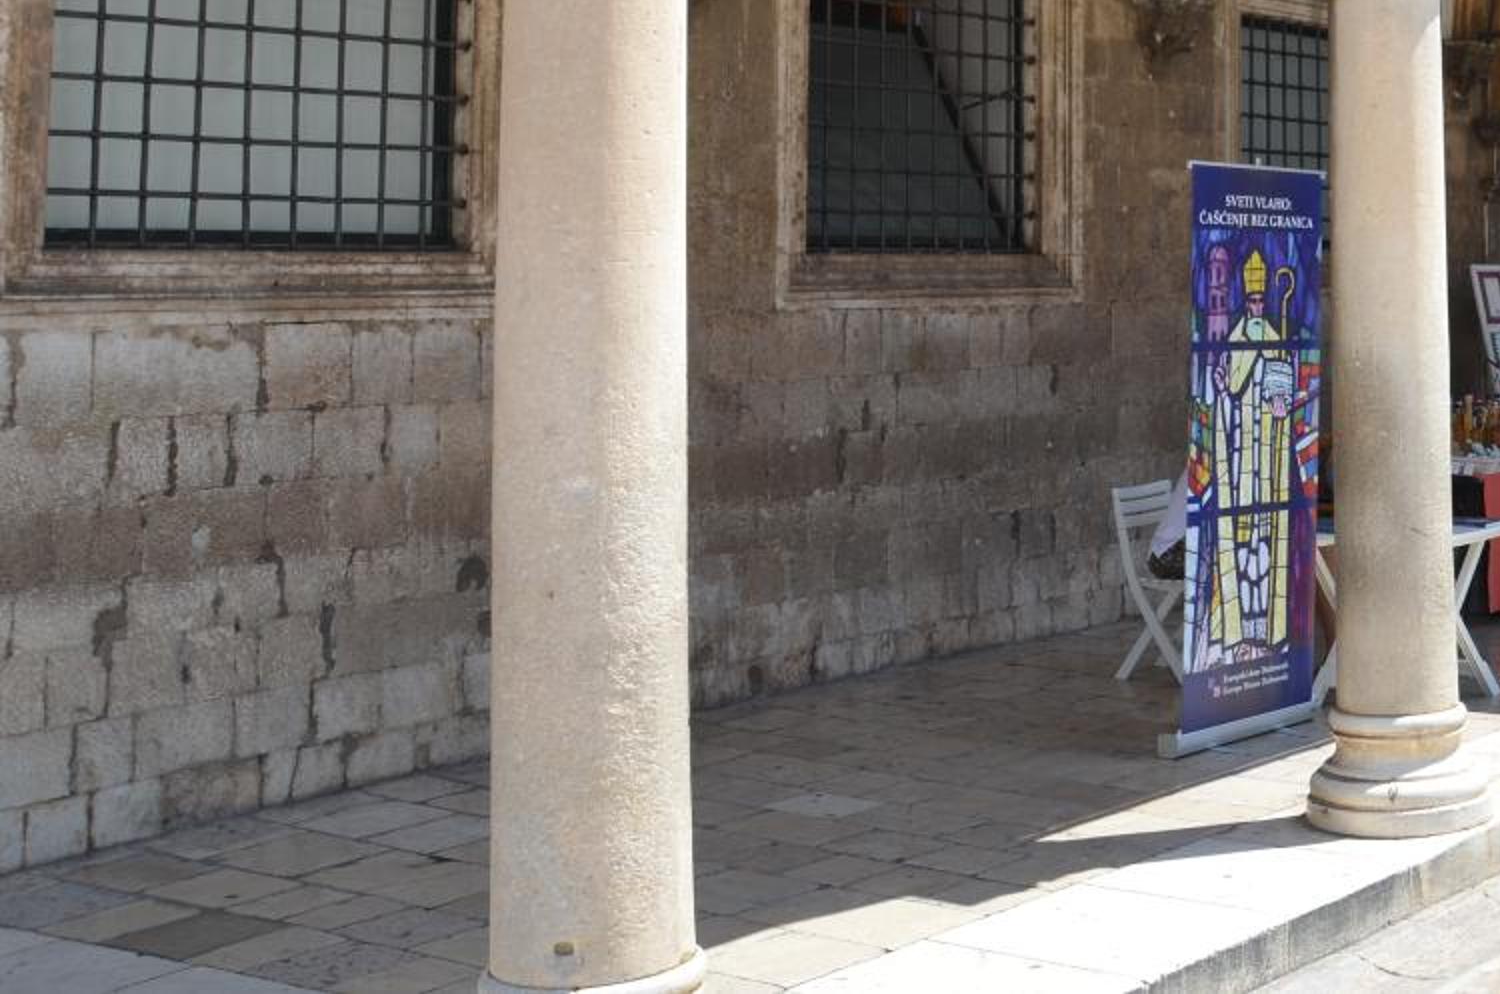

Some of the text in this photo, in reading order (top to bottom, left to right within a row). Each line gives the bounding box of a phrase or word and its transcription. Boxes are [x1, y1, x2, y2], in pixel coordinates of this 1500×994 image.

[1225, 195, 1253, 209] SVETI
[1251, 213, 1268, 227] BEZ
[1270, 215, 1313, 229] GRANICA
